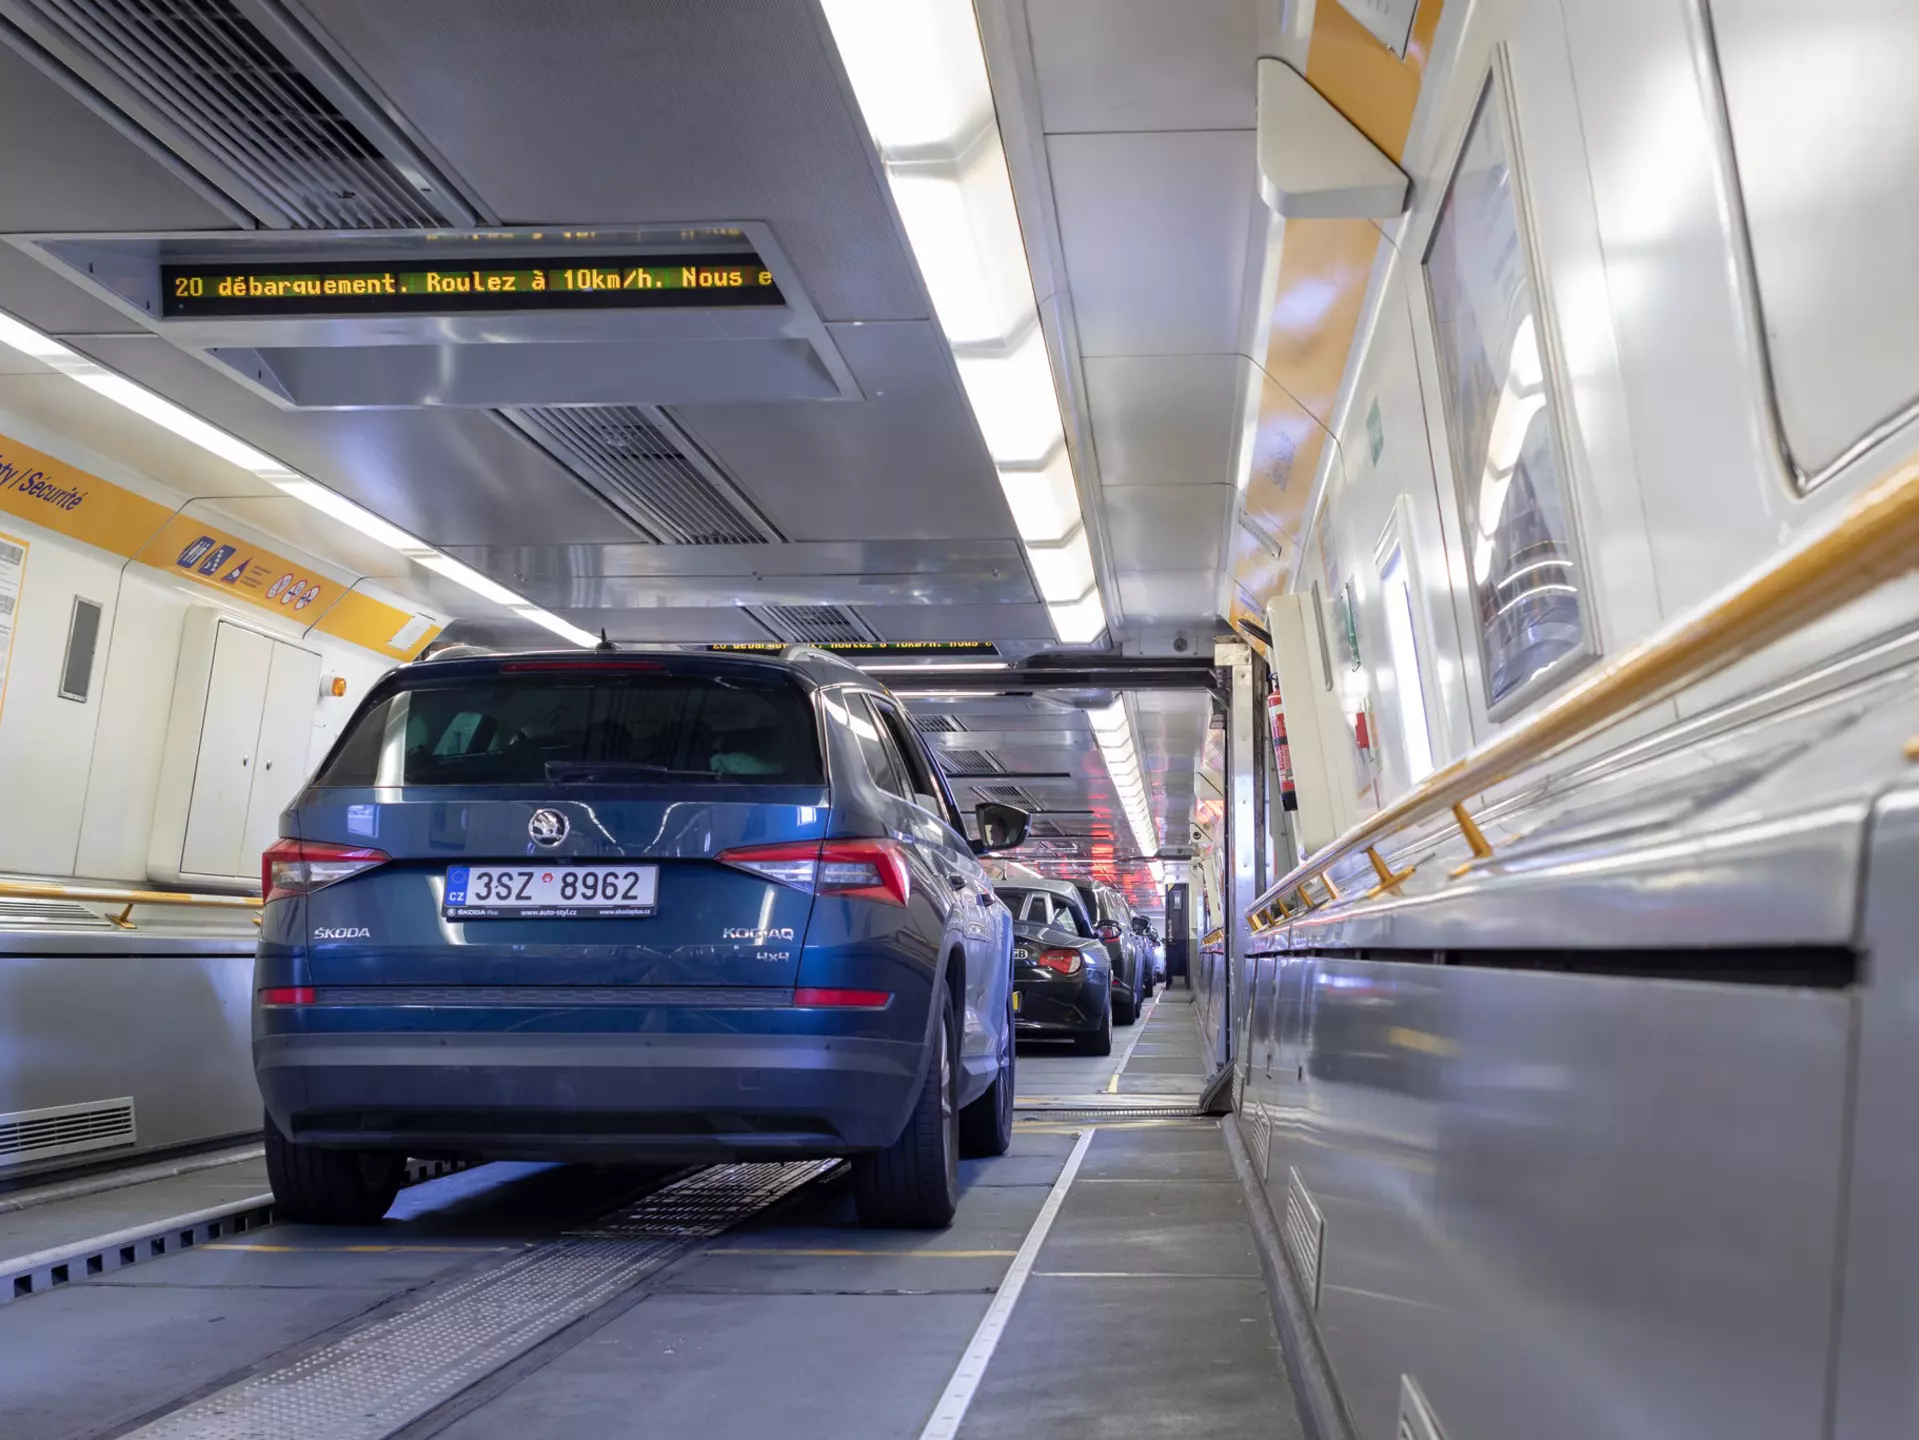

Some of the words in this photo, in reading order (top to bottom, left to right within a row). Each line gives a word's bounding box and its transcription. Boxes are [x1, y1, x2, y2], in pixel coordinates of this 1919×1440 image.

[175, 278, 203, 297] 20
[218, 273, 407, 297] débarquement.
[427, 271, 515, 292] Roulez
[532, 270, 546, 290] à
[564, 267, 663, 290] 10km/h.
[682, 267, 742, 287] Nous
[18, 471, 88, 511] Sécurité
[475, 871, 535, 901] 3SZ
[560, 871, 640, 901] 8962
[449, 892, 465, 902] CZ
[520, 908, 577, 917] www.auto-styl.cz
[313, 926, 371, 940] ŠKODA
[756, 951, 790, 962] 4x4
